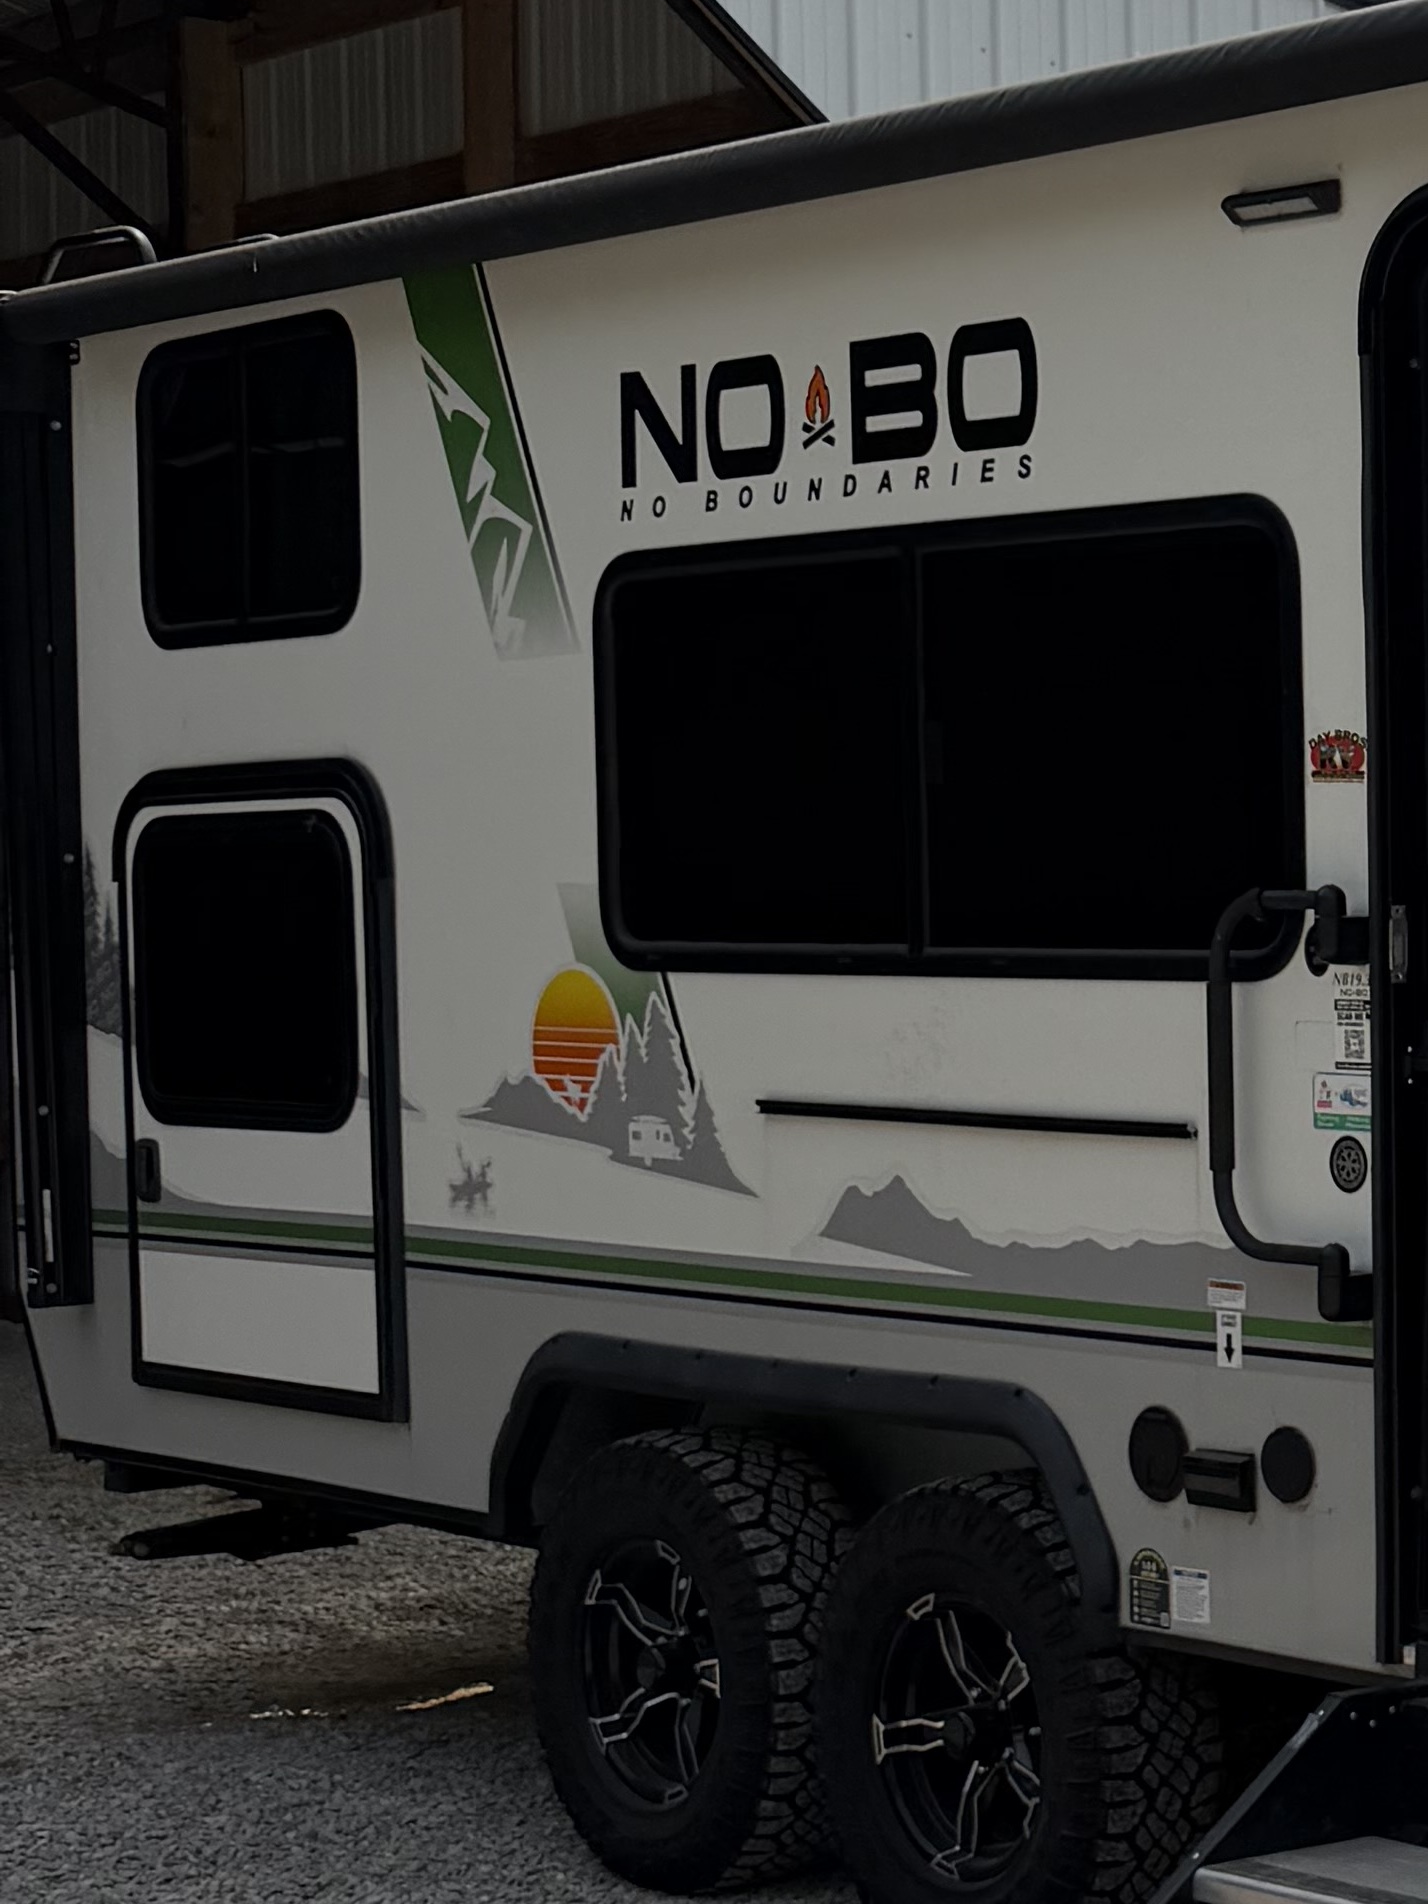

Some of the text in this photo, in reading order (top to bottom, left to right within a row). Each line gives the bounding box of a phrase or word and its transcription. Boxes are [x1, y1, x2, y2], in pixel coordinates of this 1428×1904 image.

[620, 454, 1033, 522] NO BOUNDARIES
[1308, 730, 1331, 750] DAY
[1319, 745, 1355, 769] RV
